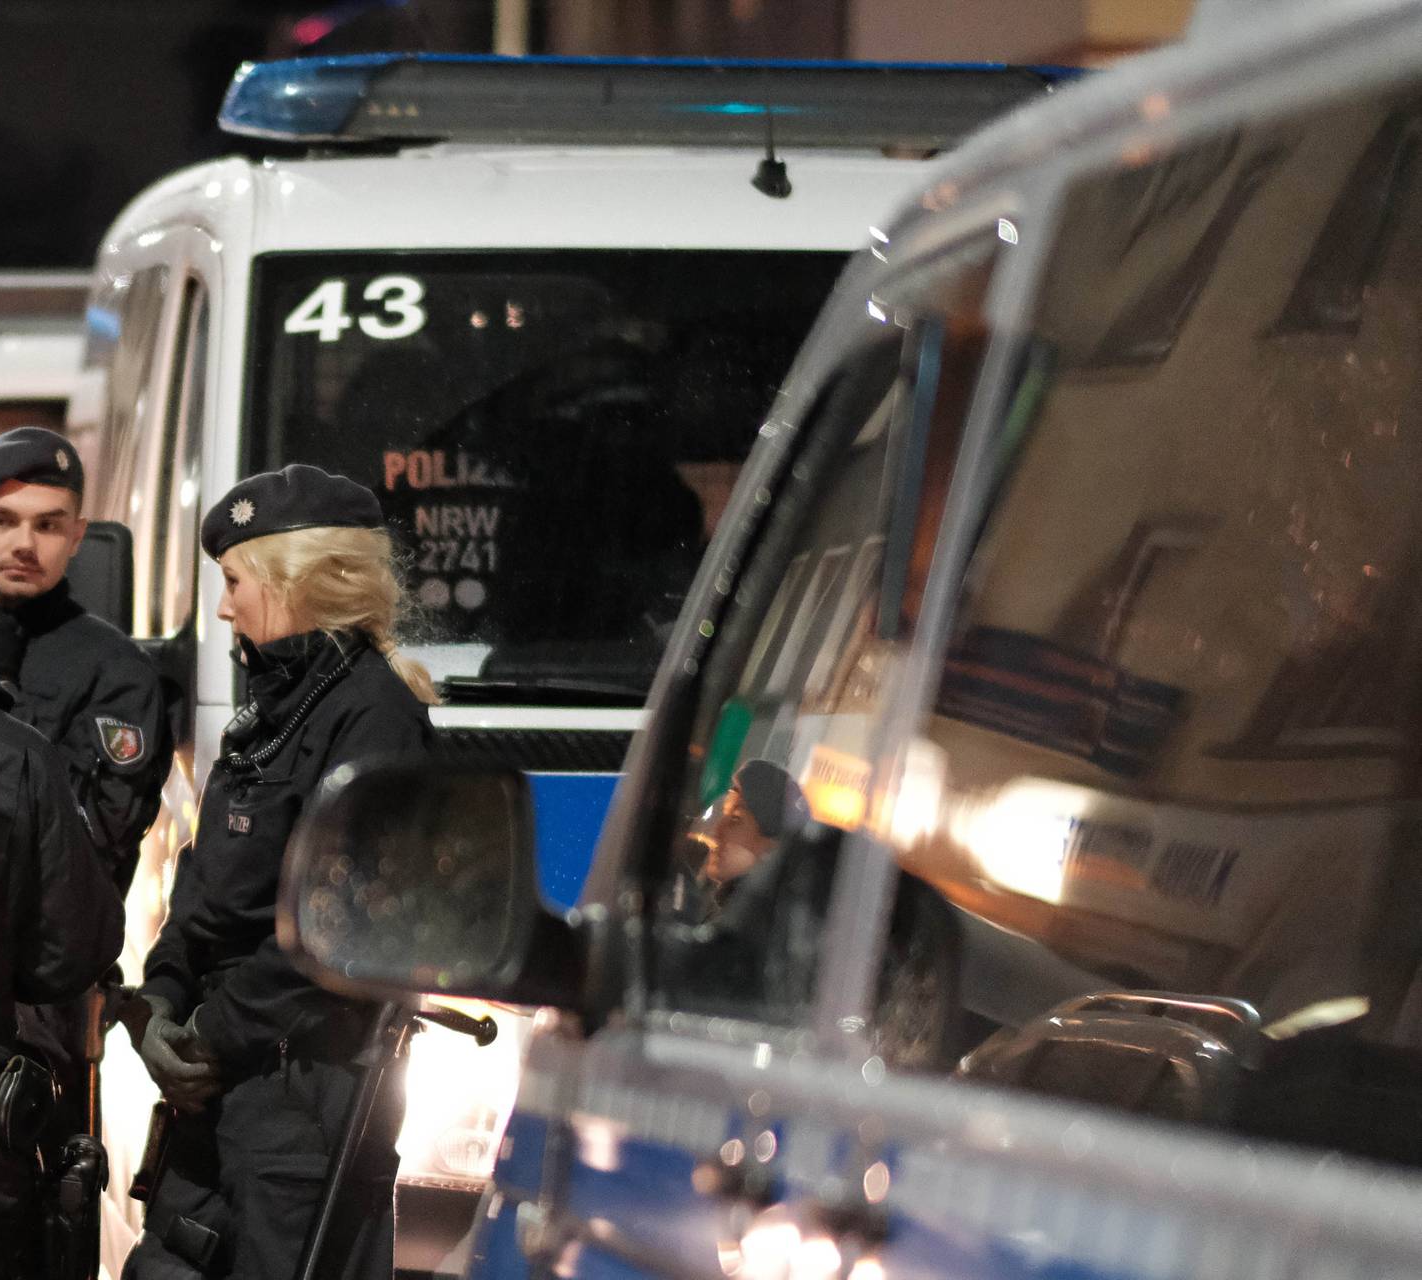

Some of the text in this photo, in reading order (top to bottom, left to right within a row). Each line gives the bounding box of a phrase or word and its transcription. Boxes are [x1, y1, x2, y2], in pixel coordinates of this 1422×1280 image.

[284, 275, 426, 342] 43
[384, 450, 518, 491] POLIZ
[416, 506, 500, 536] NRW
[418, 541, 498, 572] 2741
